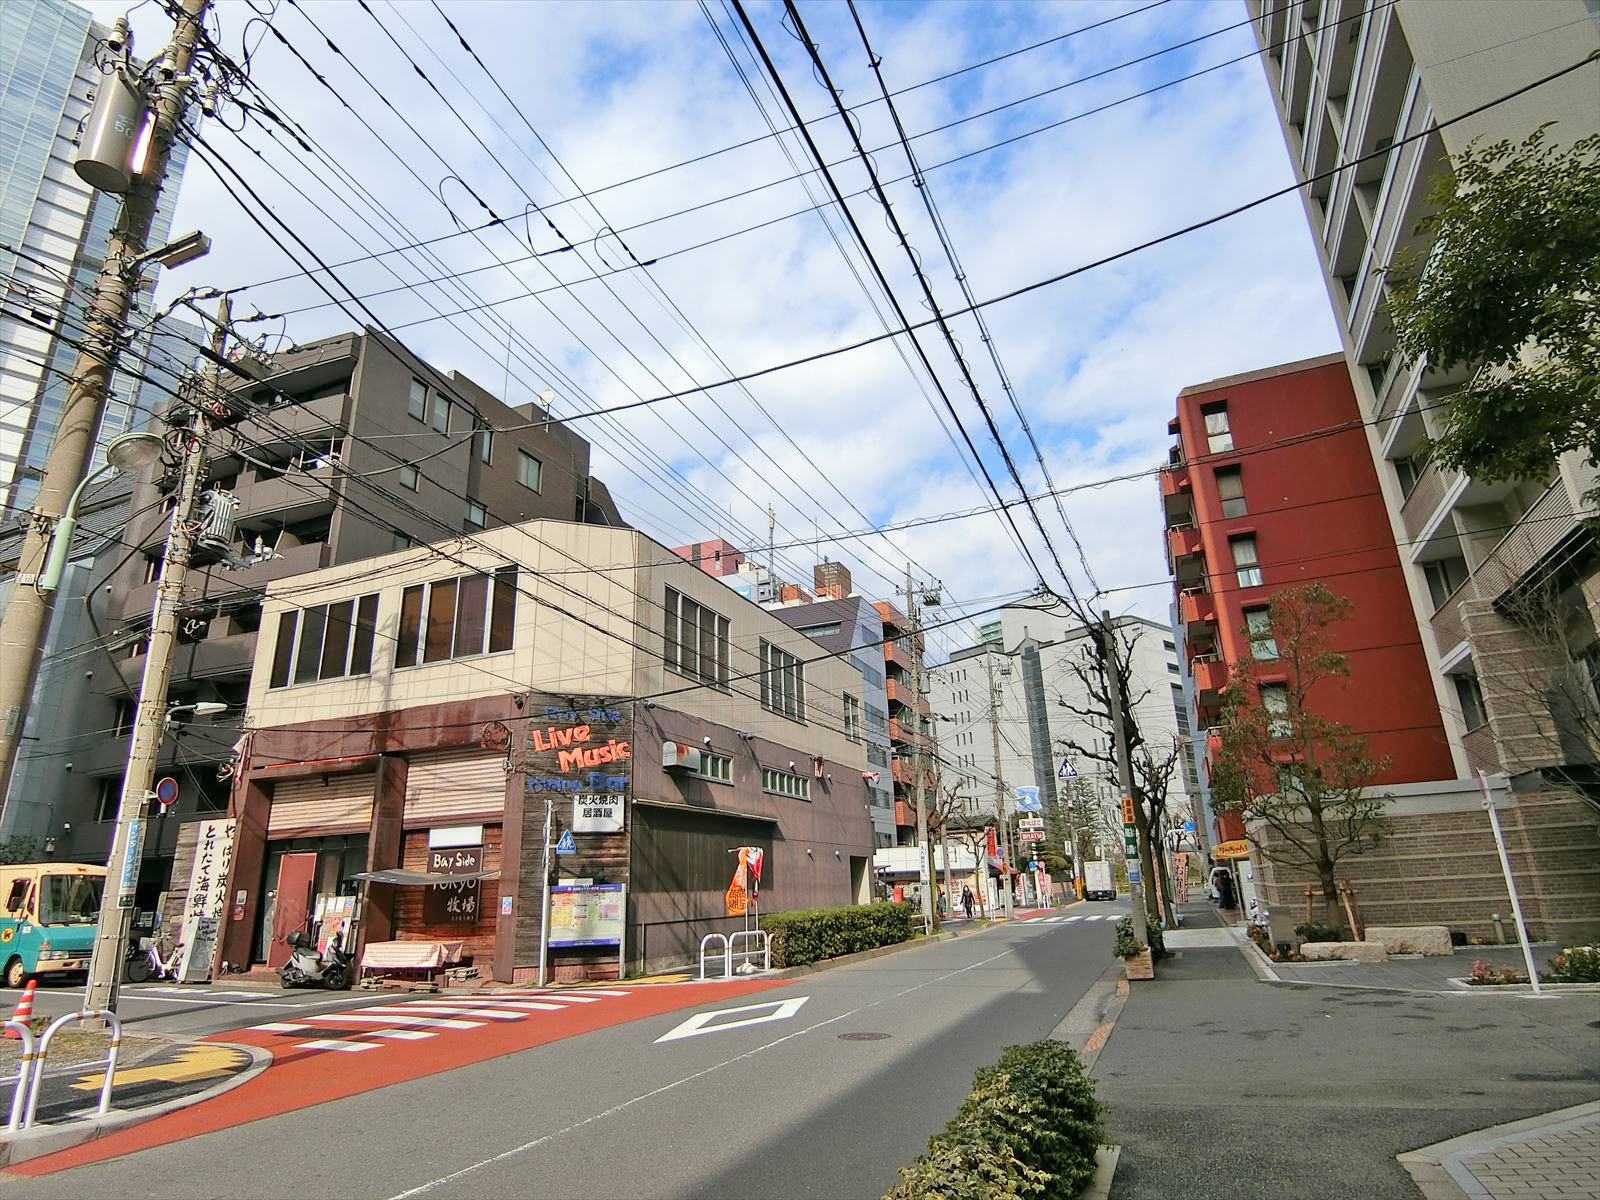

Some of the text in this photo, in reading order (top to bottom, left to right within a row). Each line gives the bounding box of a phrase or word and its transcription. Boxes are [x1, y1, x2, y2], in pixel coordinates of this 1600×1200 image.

[532, 724, 591, 752] Live
[558, 739, 631, 774] Music
[578, 794, 618, 805] 炭火焼肉
[582, 808, 613, 818] 居酒屋
[433, 852, 476, 869] Bay Side
[447, 895, 476, 913] 牧場
